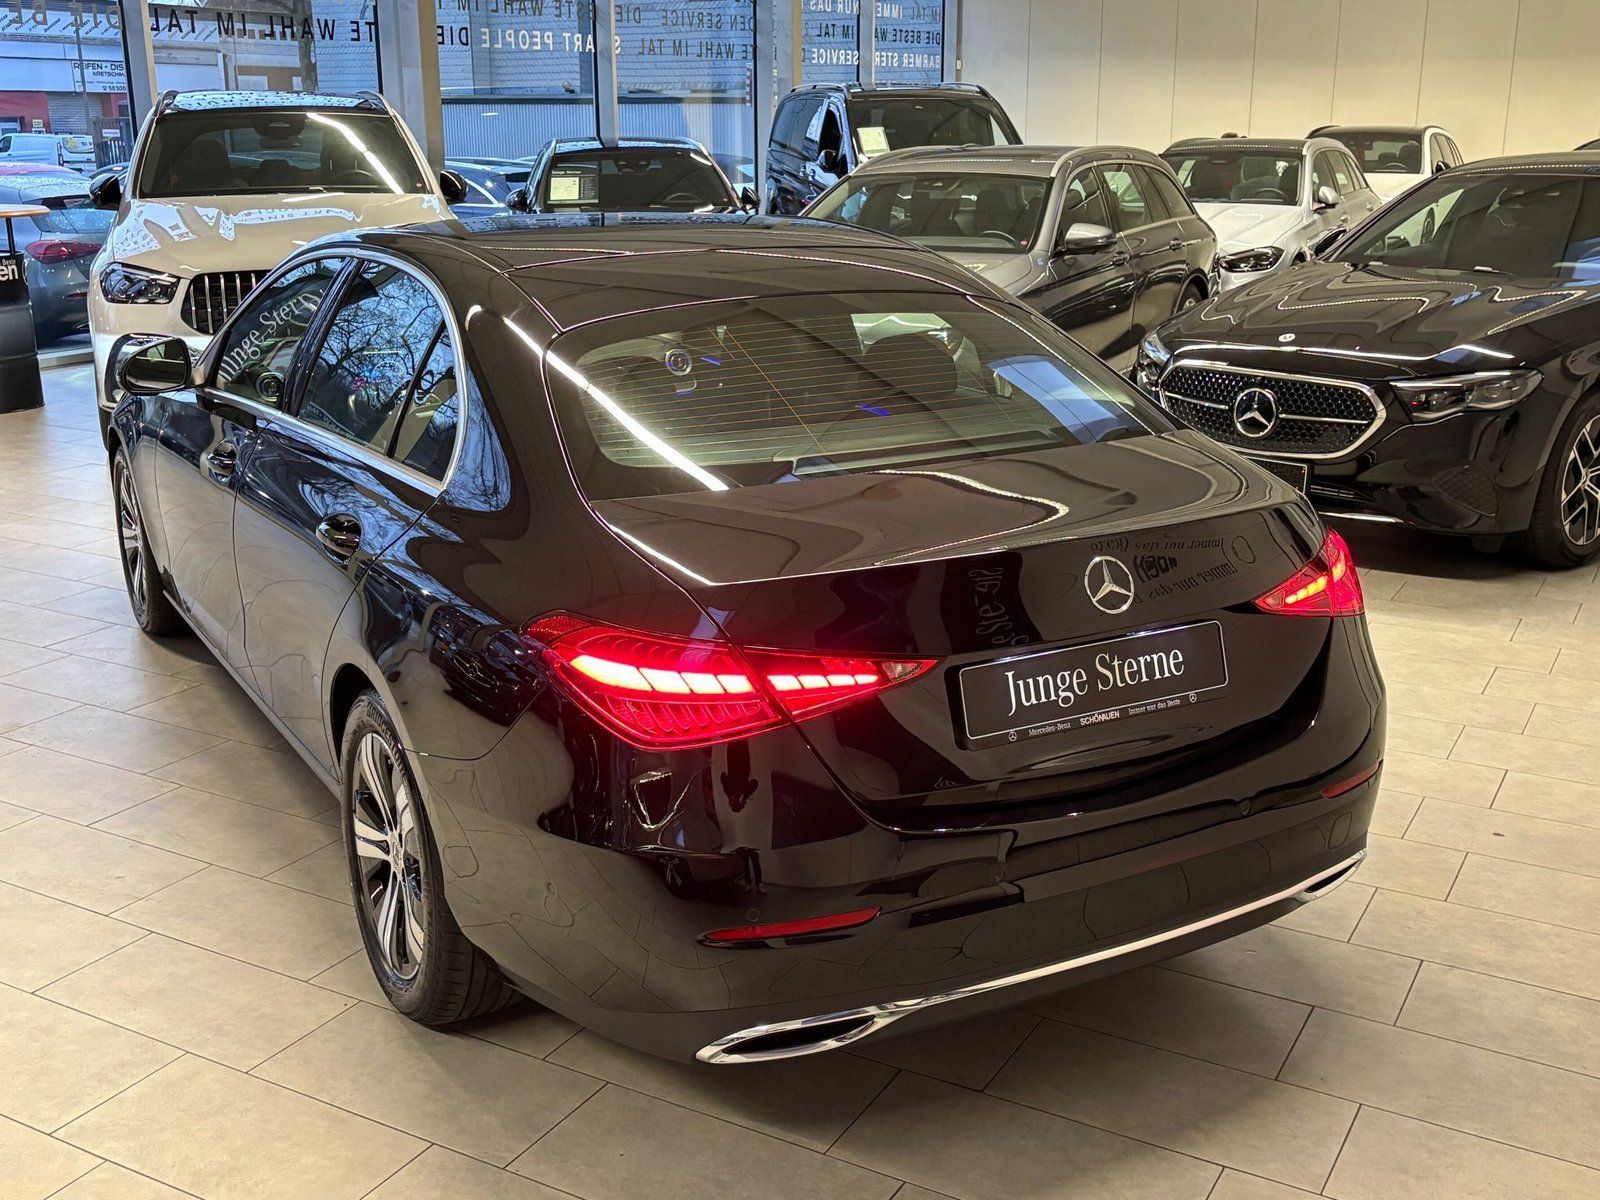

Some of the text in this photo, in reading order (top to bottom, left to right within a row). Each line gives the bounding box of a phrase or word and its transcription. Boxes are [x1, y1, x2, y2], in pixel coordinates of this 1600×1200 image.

[1005, 647, 1185, 717] Junge Sterne
[1028, 722, 1071, 736] Mercedes-Benz
[1080, 710, 1120, 726] SCHÖNAUEN
[1128, 706, 1146, 715] Immer
[1157, 701, 1167, 710] das
